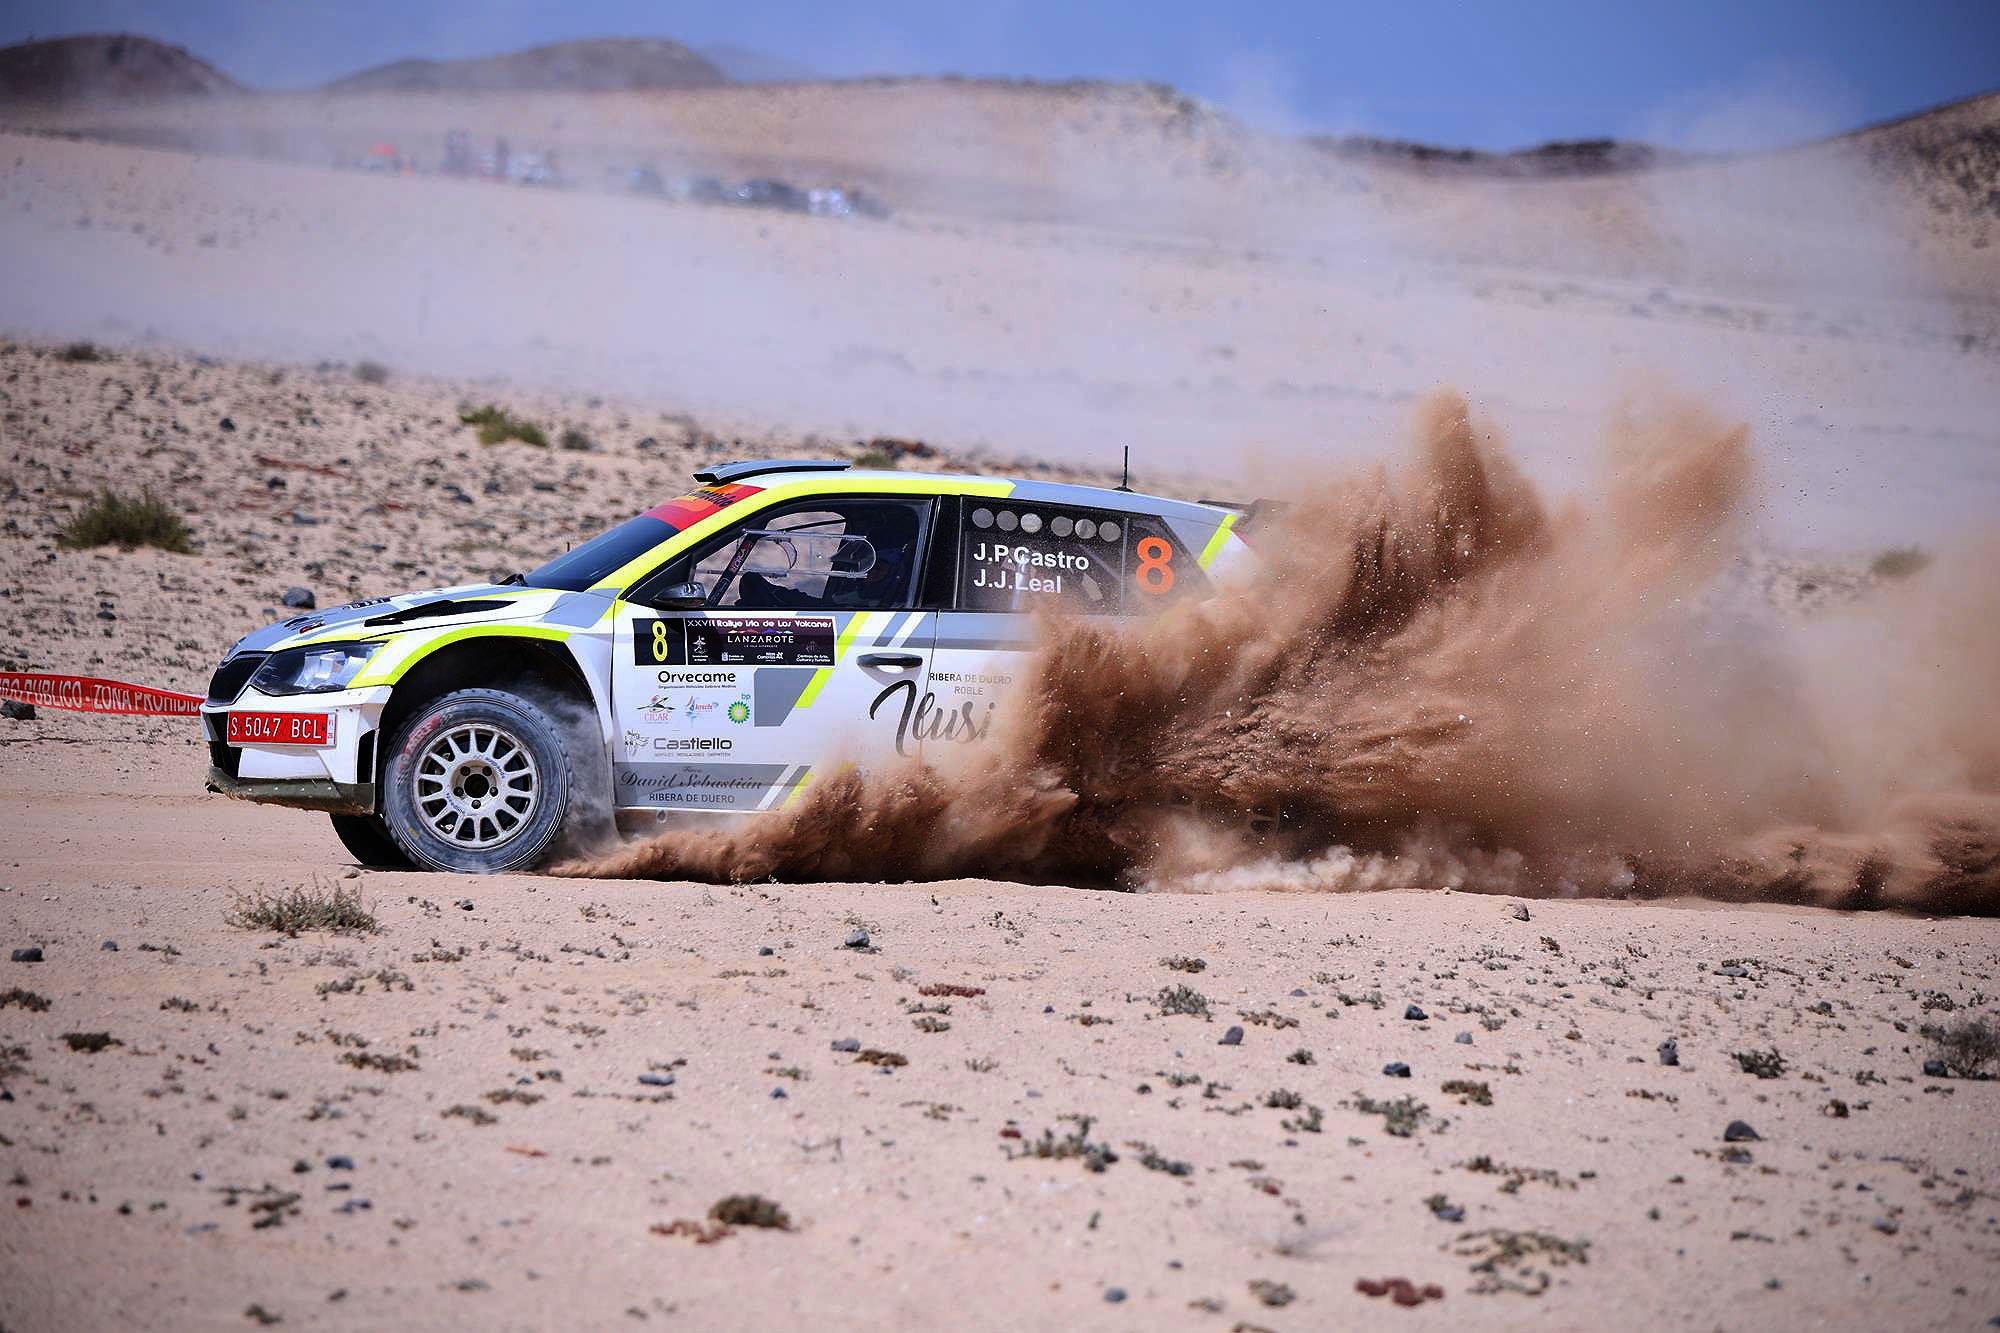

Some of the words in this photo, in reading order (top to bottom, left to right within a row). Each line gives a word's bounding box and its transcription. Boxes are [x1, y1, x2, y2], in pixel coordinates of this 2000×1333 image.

[973, 542, 1089, 570] J.P.Castro
[1135, 536, 1174, 594] 8
[973, 568, 1061, 594] J.J.Leal
[717, 619, 743, 628] Rallye
[763, 619, 774, 627] de
[778, 619, 791, 627] Los
[795, 619, 832, 628] Volcanes
[652, 620, 668, 662] 8
[728, 635, 794, 644] LANZAROTE
[657, 670, 736, 683] Orvecame
[929, 672, 962, 682] RIBERA
[965, 674, 977, 683] DE
[93, 684, 132, 711] ZONA
[954, 686, 984, 696] ROBLE
[231, 716, 238, 736] S
[245, 716, 281, 737] 5047
[291, 718, 322, 739] BCL
[653, 737, 733, 750] Castiello
[621, 770, 678, 788] David
[649, 792, 684, 802] RIBERA
[686, 793, 699, 802] DE
[701, 794, 735, 803] DUERO
